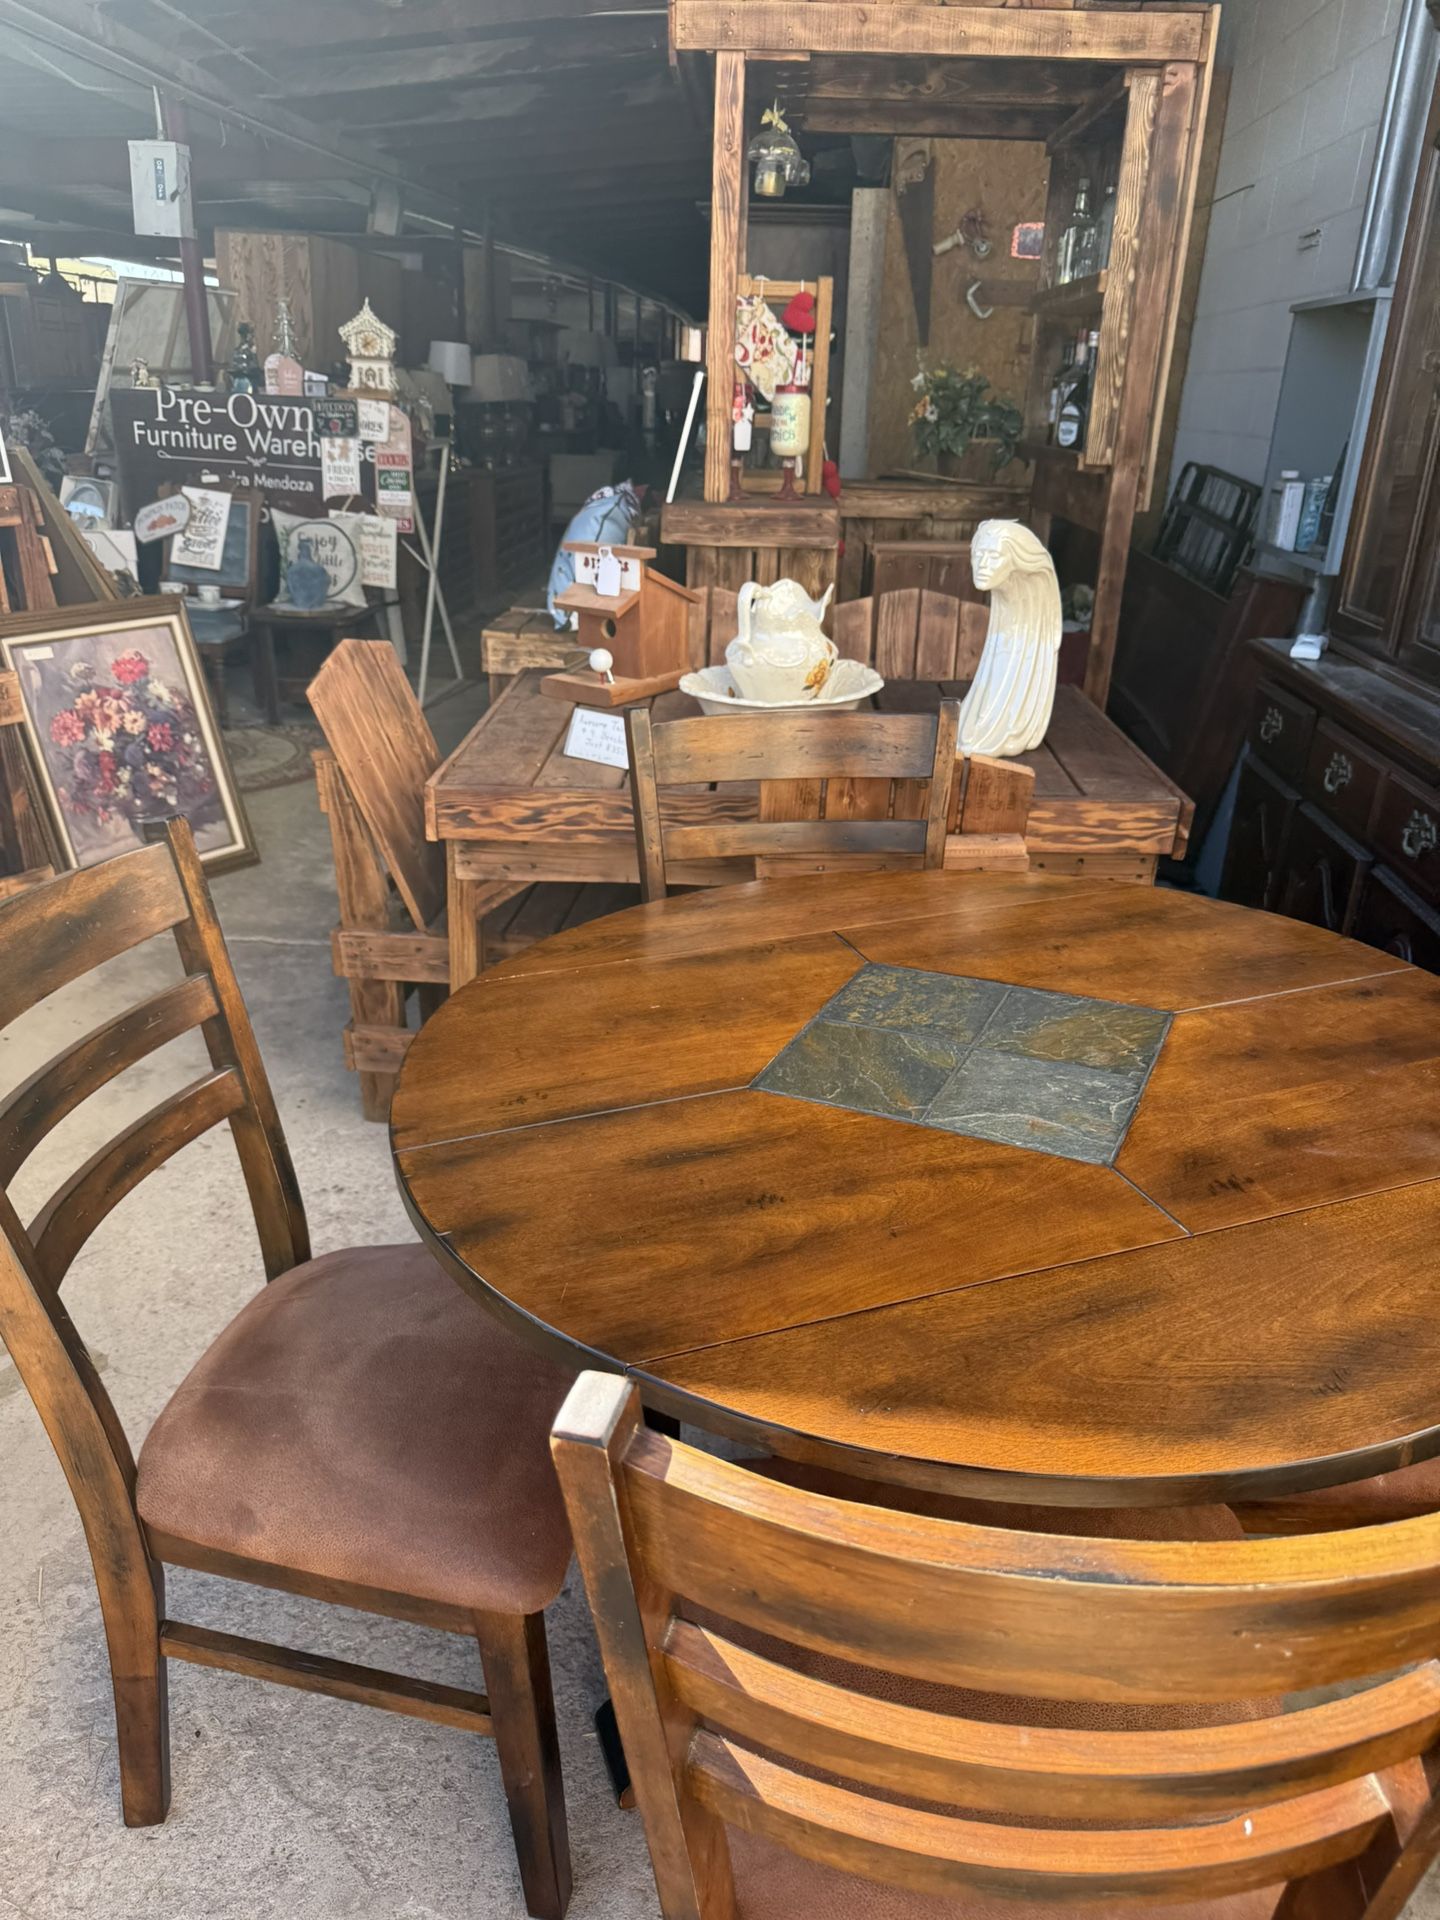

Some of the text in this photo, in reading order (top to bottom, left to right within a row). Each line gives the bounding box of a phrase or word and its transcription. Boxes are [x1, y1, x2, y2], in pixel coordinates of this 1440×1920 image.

[155, 389, 314, 432] Pre-Own
[133, 421, 377, 463] Furniture Warehse
[254, 472, 314, 493] Mendoza
